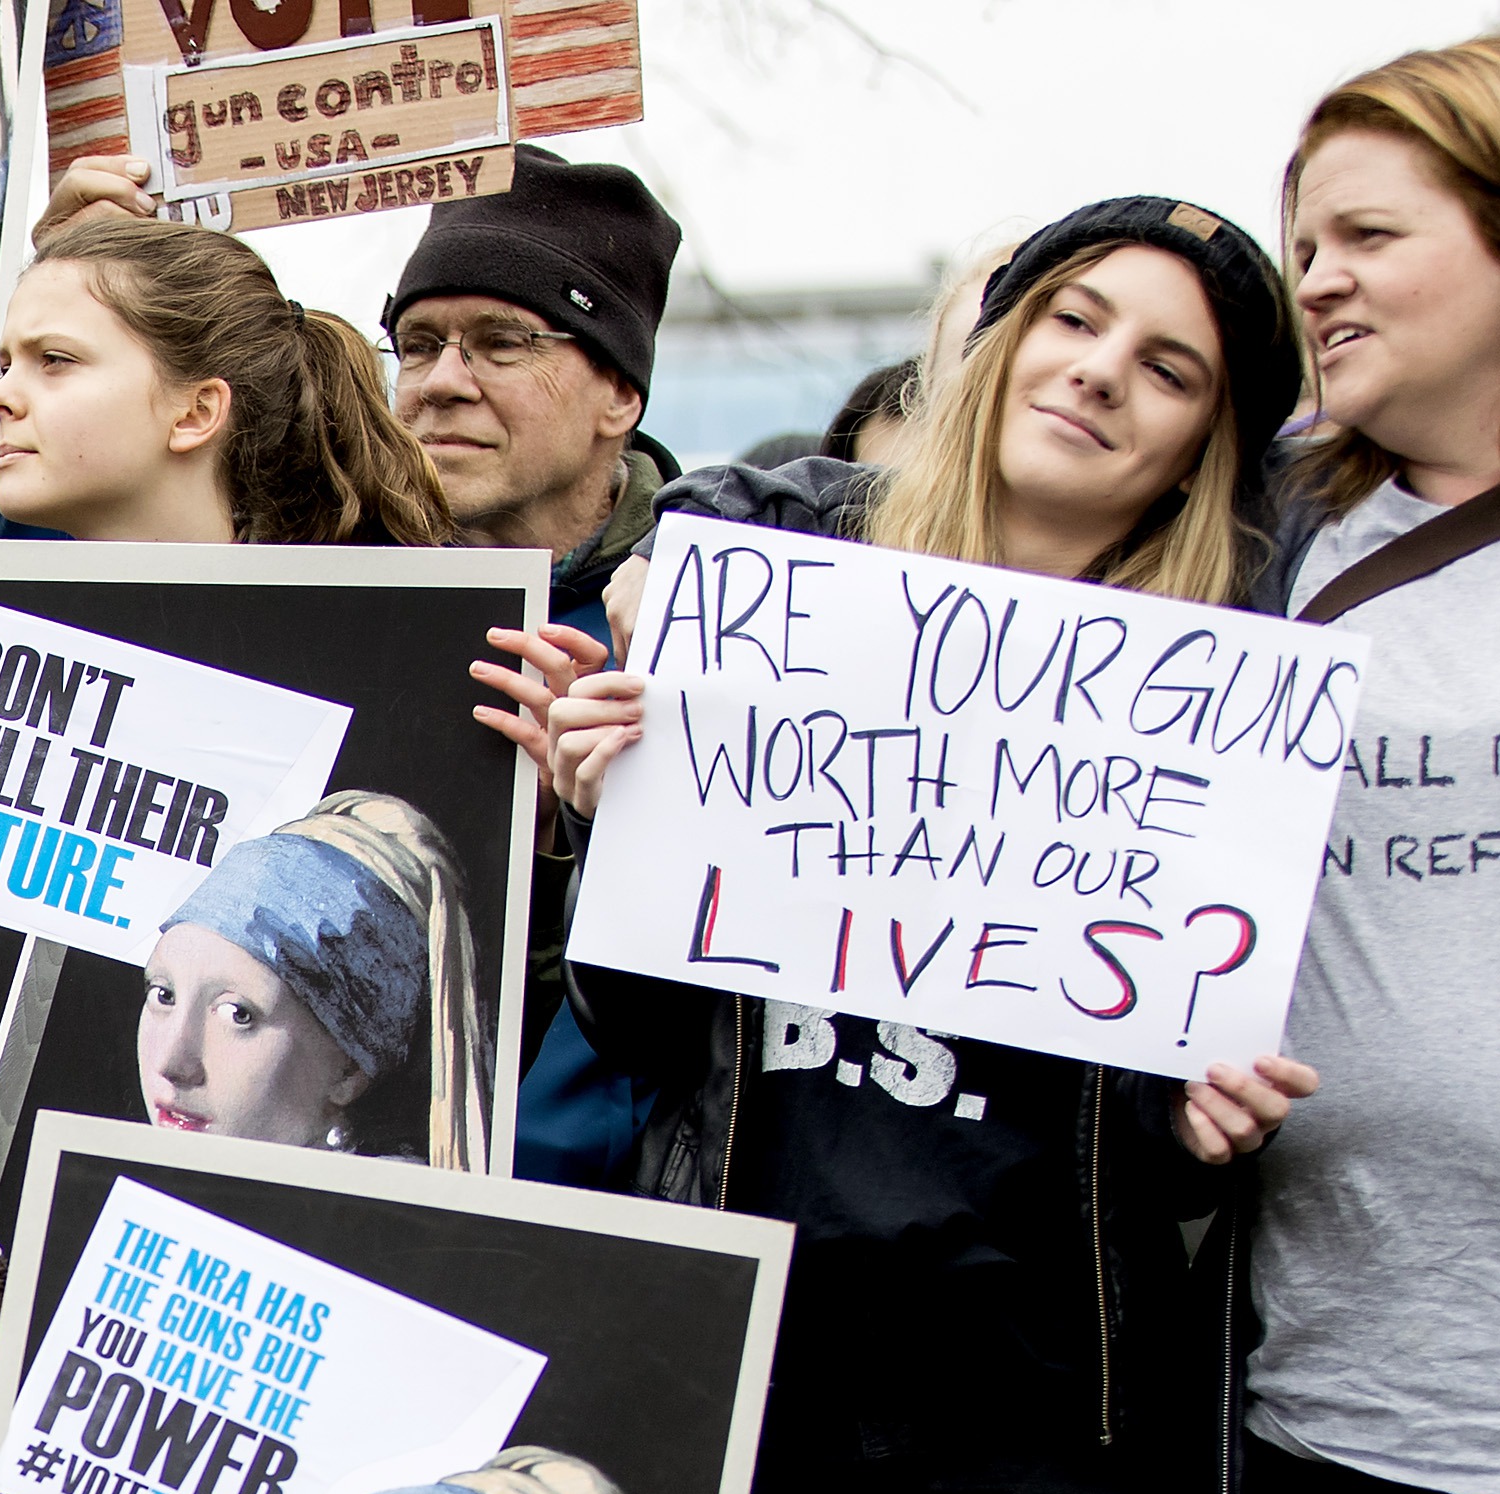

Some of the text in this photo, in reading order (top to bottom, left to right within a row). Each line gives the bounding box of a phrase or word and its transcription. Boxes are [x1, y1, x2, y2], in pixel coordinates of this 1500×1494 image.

[163, 27, 498, 168] gun control
[275, 177, 350, 219] NEW
[355, 156, 485, 212] JERSEY
[649, 543, 1359, 772] ARE YOUR GUNS
[59, 746, 229, 868] THEIR
[680, 689, 1211, 839] WORTH MORE
[764, 817, 1161, 908] THAN OUR
[687, 863, 1258, 1049] LIVES?
[92, 1262, 326, 1395] THE GUNS BUT
[111, 1219, 332, 1345] THE NRA HAS
[75, 1307, 312, 1441] YOU HAVE THE
